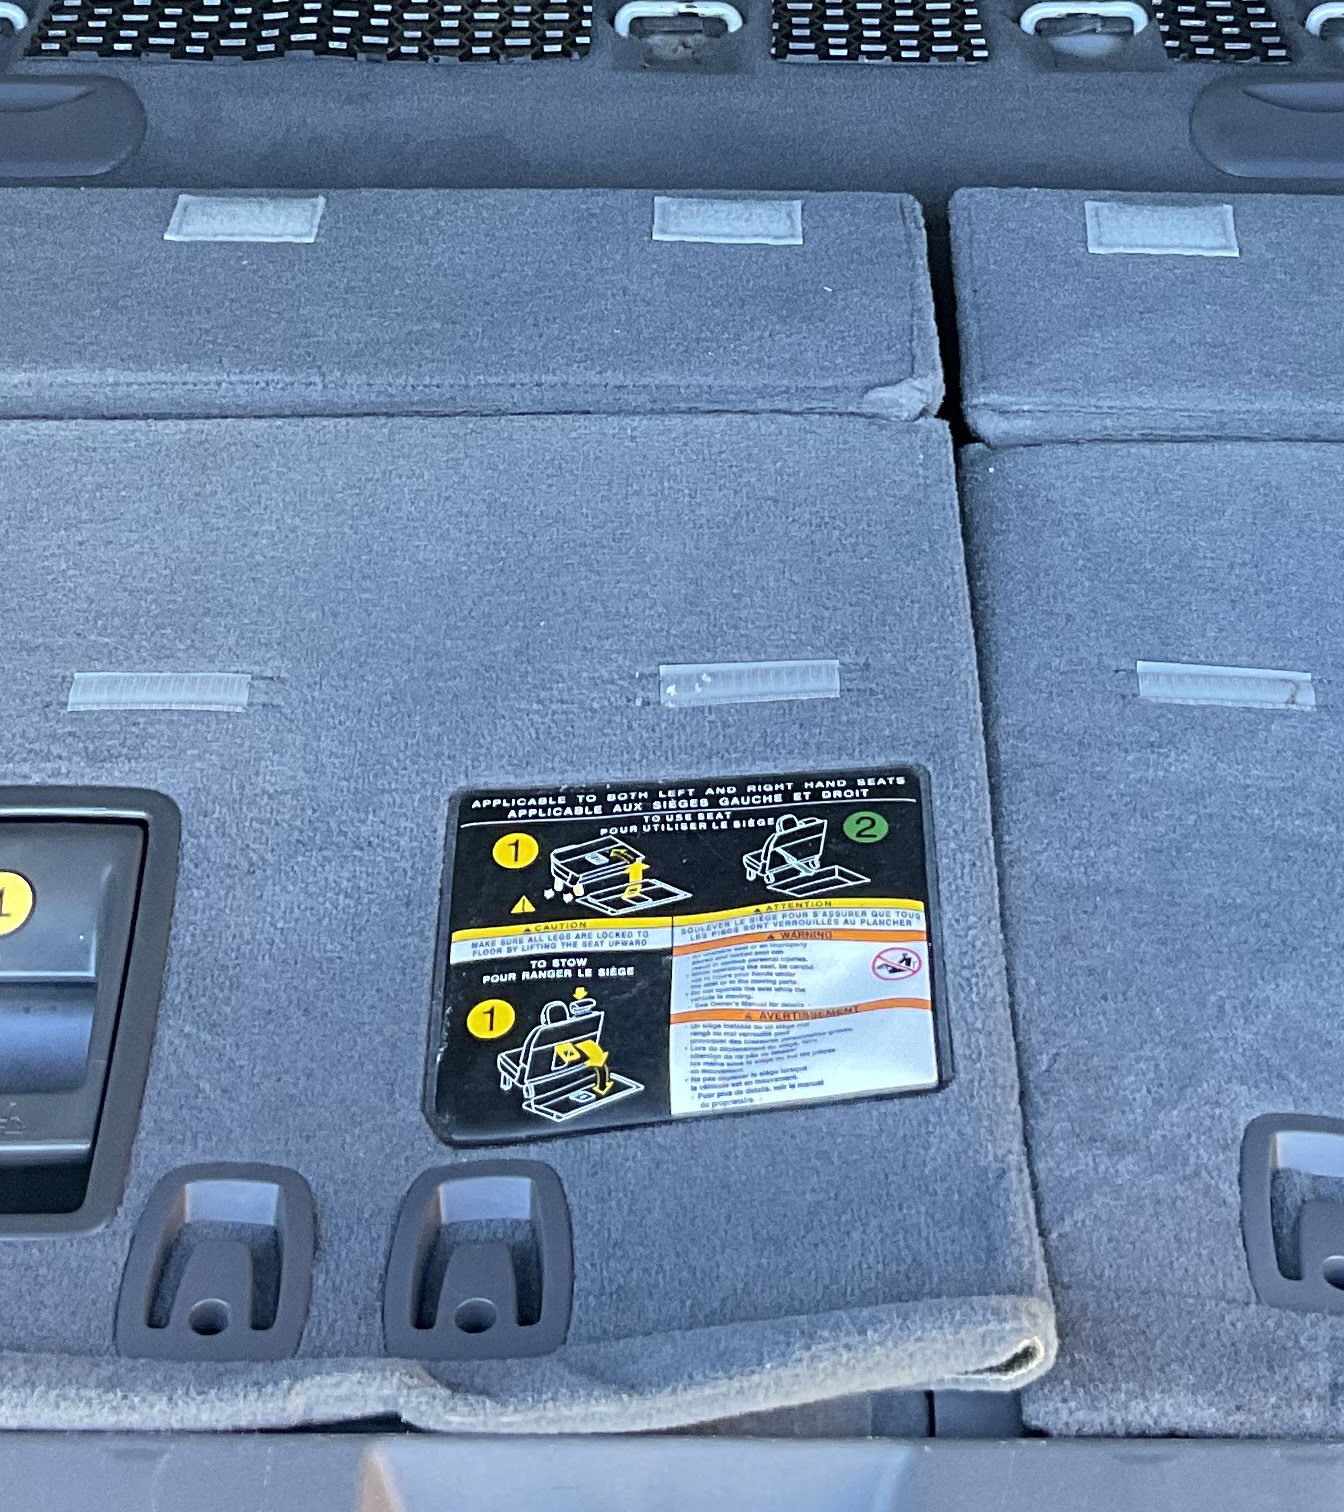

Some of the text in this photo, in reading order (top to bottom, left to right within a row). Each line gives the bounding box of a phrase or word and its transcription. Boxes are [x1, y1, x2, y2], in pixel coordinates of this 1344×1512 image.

[471, 776, 906, 808] APPLICABLE TO BOTH LEFT AND RIGHT HAND SEATS
[507, 788, 869, 819] APPLICABLE AUX SIÈGES GAUCHE ET DROIT
[643, 811, 732, 823] TO USE SEAT
[600, 817, 775, 837] POUR UTILISER LE SIÈGE
[855, 816, 878, 838] 2
[507, 838, 521, 863] 1
[765, 900, 832, 912] ATTENTION
[534, 921, 587, 932] CAUTION
[733, 918, 746, 927] LE
[782, 910, 808, 919] POUR
[871, 909, 891, 918] QUE
[895, 910, 921, 920] TOUS
[843, 918, 856, 926] AU
[860, 918, 912, 928] PLANCHER
[471, 940, 496, 949] MAKE
[500, 938, 524, 946] SURE
[528, 935, 544, 943] ALL
[575, 932, 593, 940] ARE
[596, 930, 632, 939] LOCKED
[636, 930, 649, 938] TO
[780, 930, 833, 940] WARNING
[472, 938, 647, 957] FLOOR BY LIFTING THE SEAT UPWARD
[530, 958, 587, 969] TO STOW
[482, 964, 635, 984] POUR RANGER LE SIÈGE
[483, 1006, 499, 1032] 1
